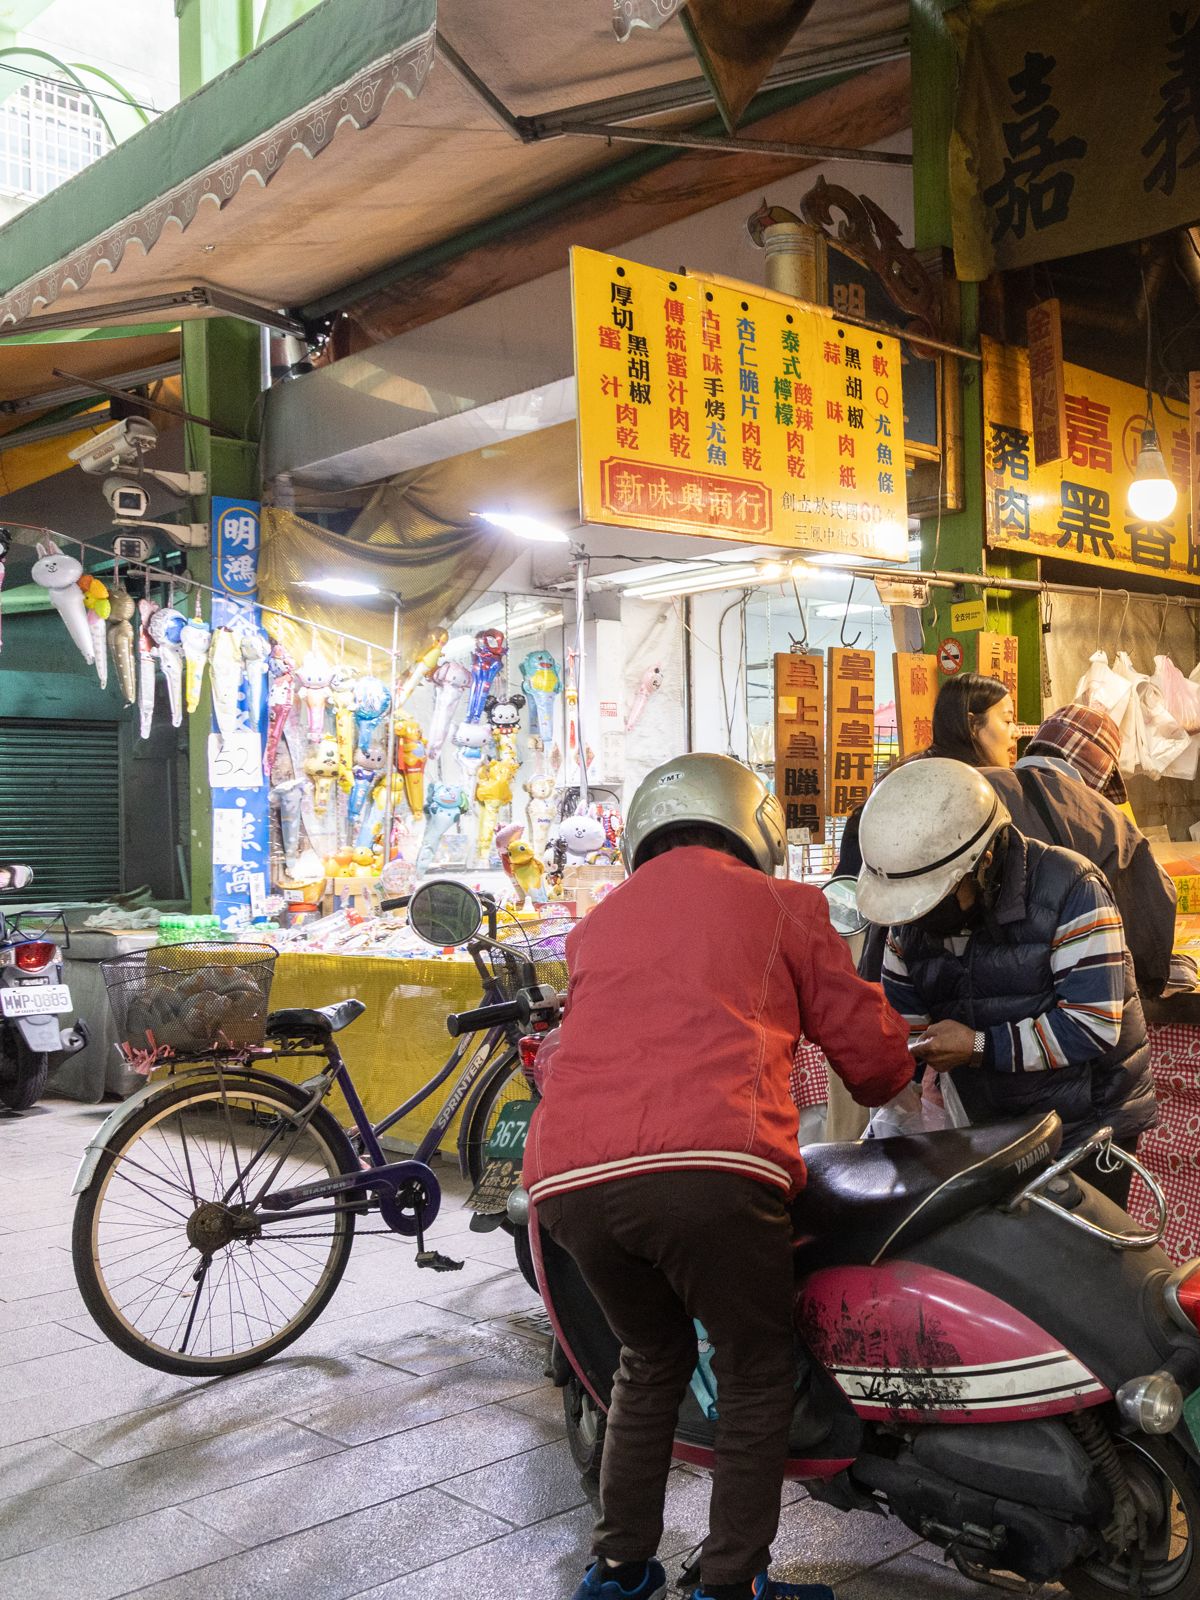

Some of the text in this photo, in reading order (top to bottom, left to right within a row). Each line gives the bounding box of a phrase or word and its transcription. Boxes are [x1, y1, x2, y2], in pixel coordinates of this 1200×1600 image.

[611, 282, 634, 331] 厚切
[599, 325, 623, 398] 蜜汁
[628, 334, 651, 405] 黑胡椒
[664, 298, 691, 459] 傳統蜜汁肉乾
[701, 309, 727, 467] 古早味手烤尤魚
[781, 329, 801, 379] 泰式
[823, 341, 844, 423] 蒜味
[844, 346, 865, 430] 黑胡椒
[615, 403, 639, 450] 肉乾
[736, 317, 762, 471] 杏仁脆片肉乾
[773, 377, 794, 427] 檸檬
[794, 382, 815, 431] 酸辣
[872, 355, 895, 494] 軟Q尤魚條
[786, 431, 806, 479] 肉乾
[838, 434, 857, 489] 肉紙
[989, 421, 1031, 541] 豬肉
[613, 472, 763, 525] 新味興商行
[223, 517, 258, 588] 明鴻
[214, 746, 258, 776] 52
[785, 659, 820, 833] 皇上皇臘腸
[834, 653, 874, 814] 皇上皇肝腸
[438, 1056, 484, 1129] SPRINTER
[491, 1120, 528, 1148] 367-
[1014, 1141, 1050, 1175] YAMAHA
